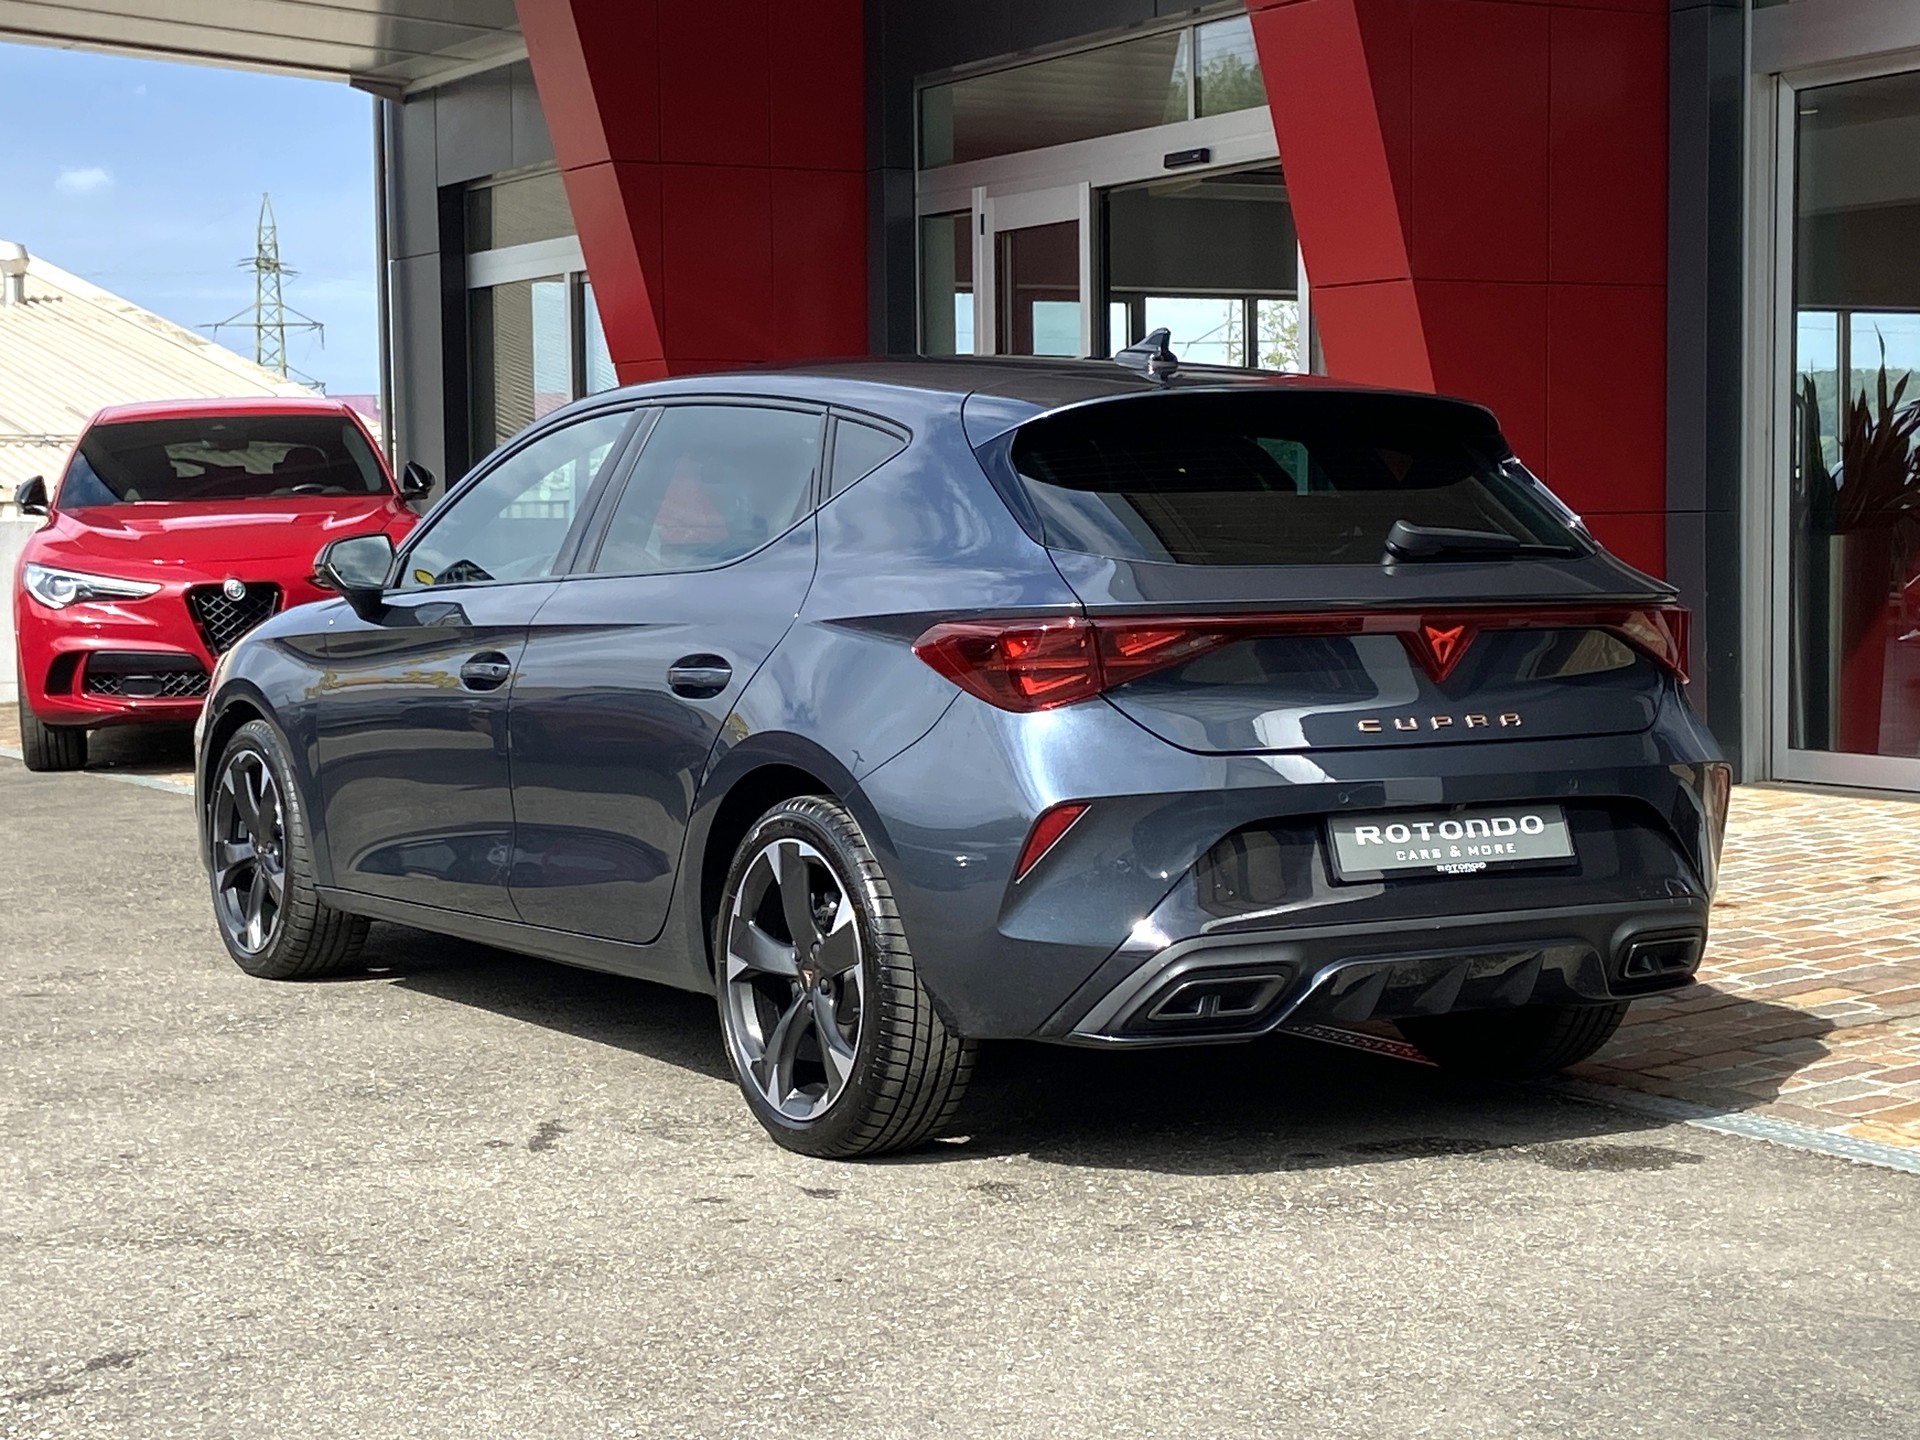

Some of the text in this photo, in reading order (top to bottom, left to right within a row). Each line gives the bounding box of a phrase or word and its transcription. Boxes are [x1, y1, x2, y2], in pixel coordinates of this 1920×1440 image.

[1357, 712, 1523, 732] CUPRA
[1354, 815, 1545, 846] ROTONDO
[1396, 843, 1517, 861] CARS & MORE
[1436, 862, 1487, 872] ROTONDO
